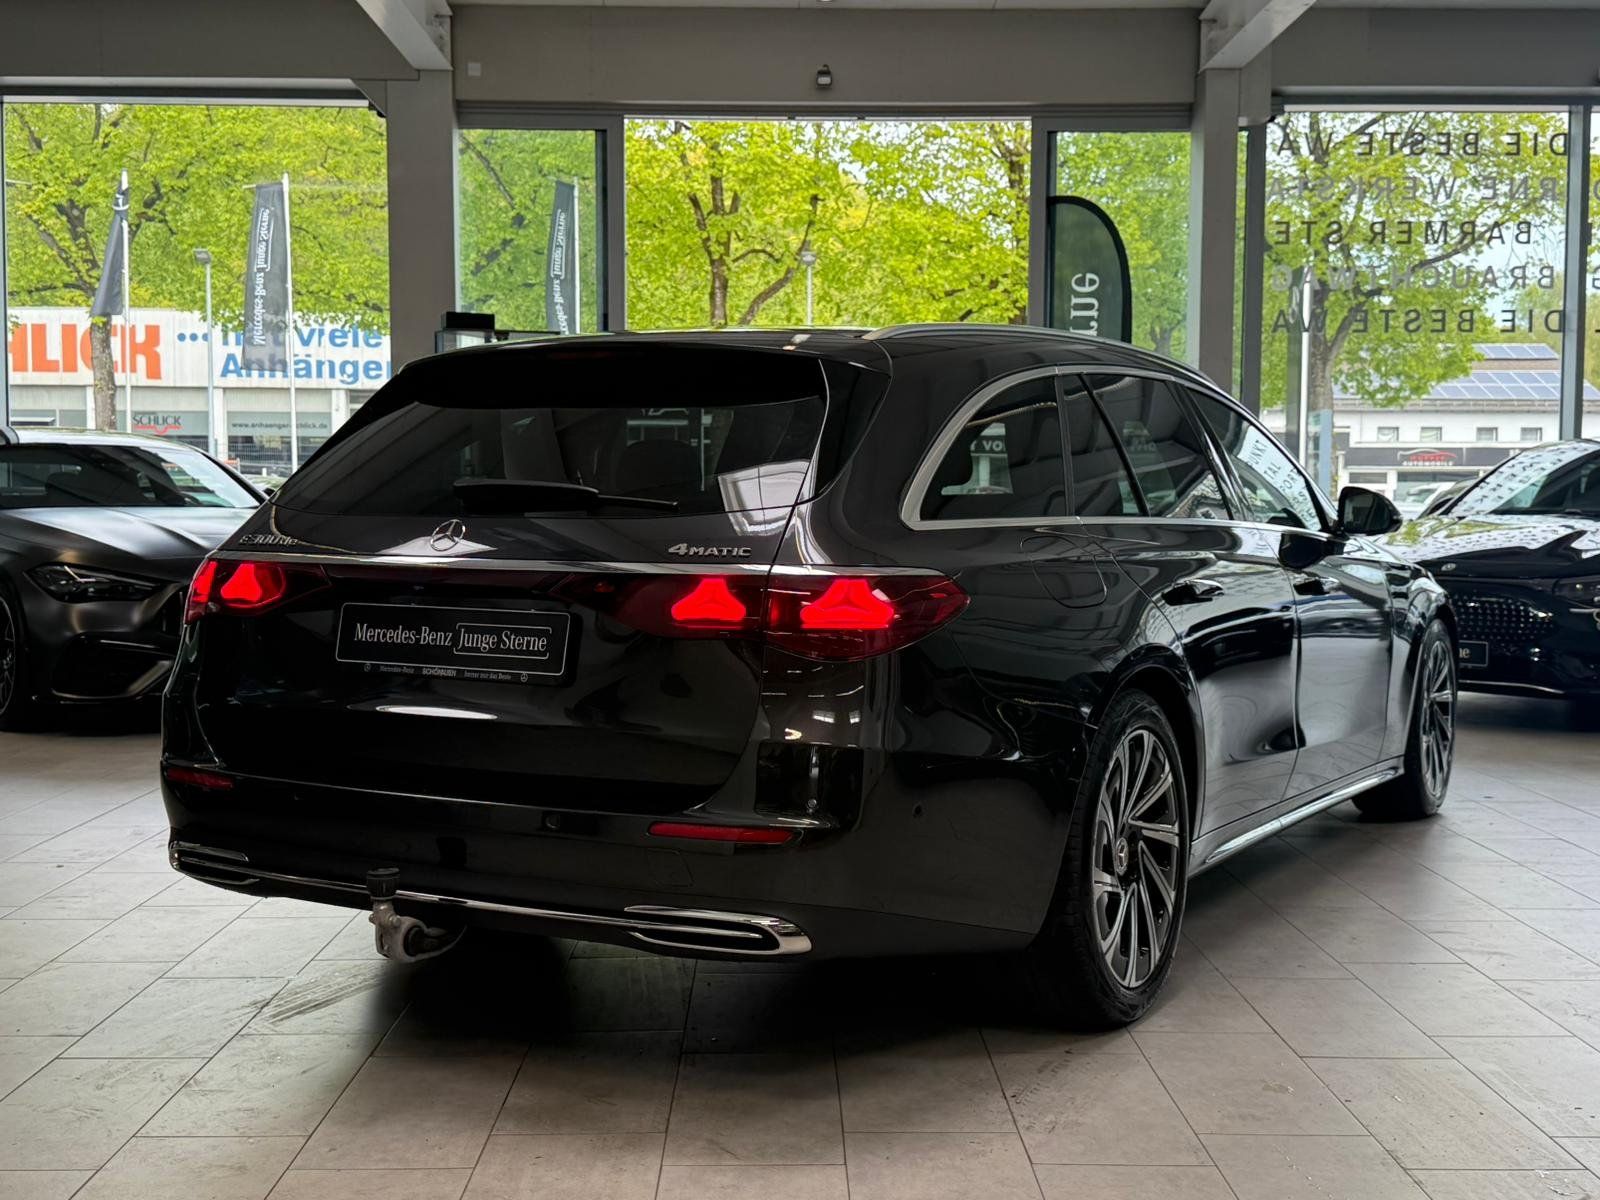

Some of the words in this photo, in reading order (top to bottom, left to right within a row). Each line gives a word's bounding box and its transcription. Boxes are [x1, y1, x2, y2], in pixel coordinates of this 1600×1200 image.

[132, 414, 182, 425] SCHLICK
[667, 542, 752, 557] 4MATIC
[354, 622, 453, 646] Mercedes-Benz
[458, 627, 498, 652] Junge
[500, 630, 547, 651] Sterne
